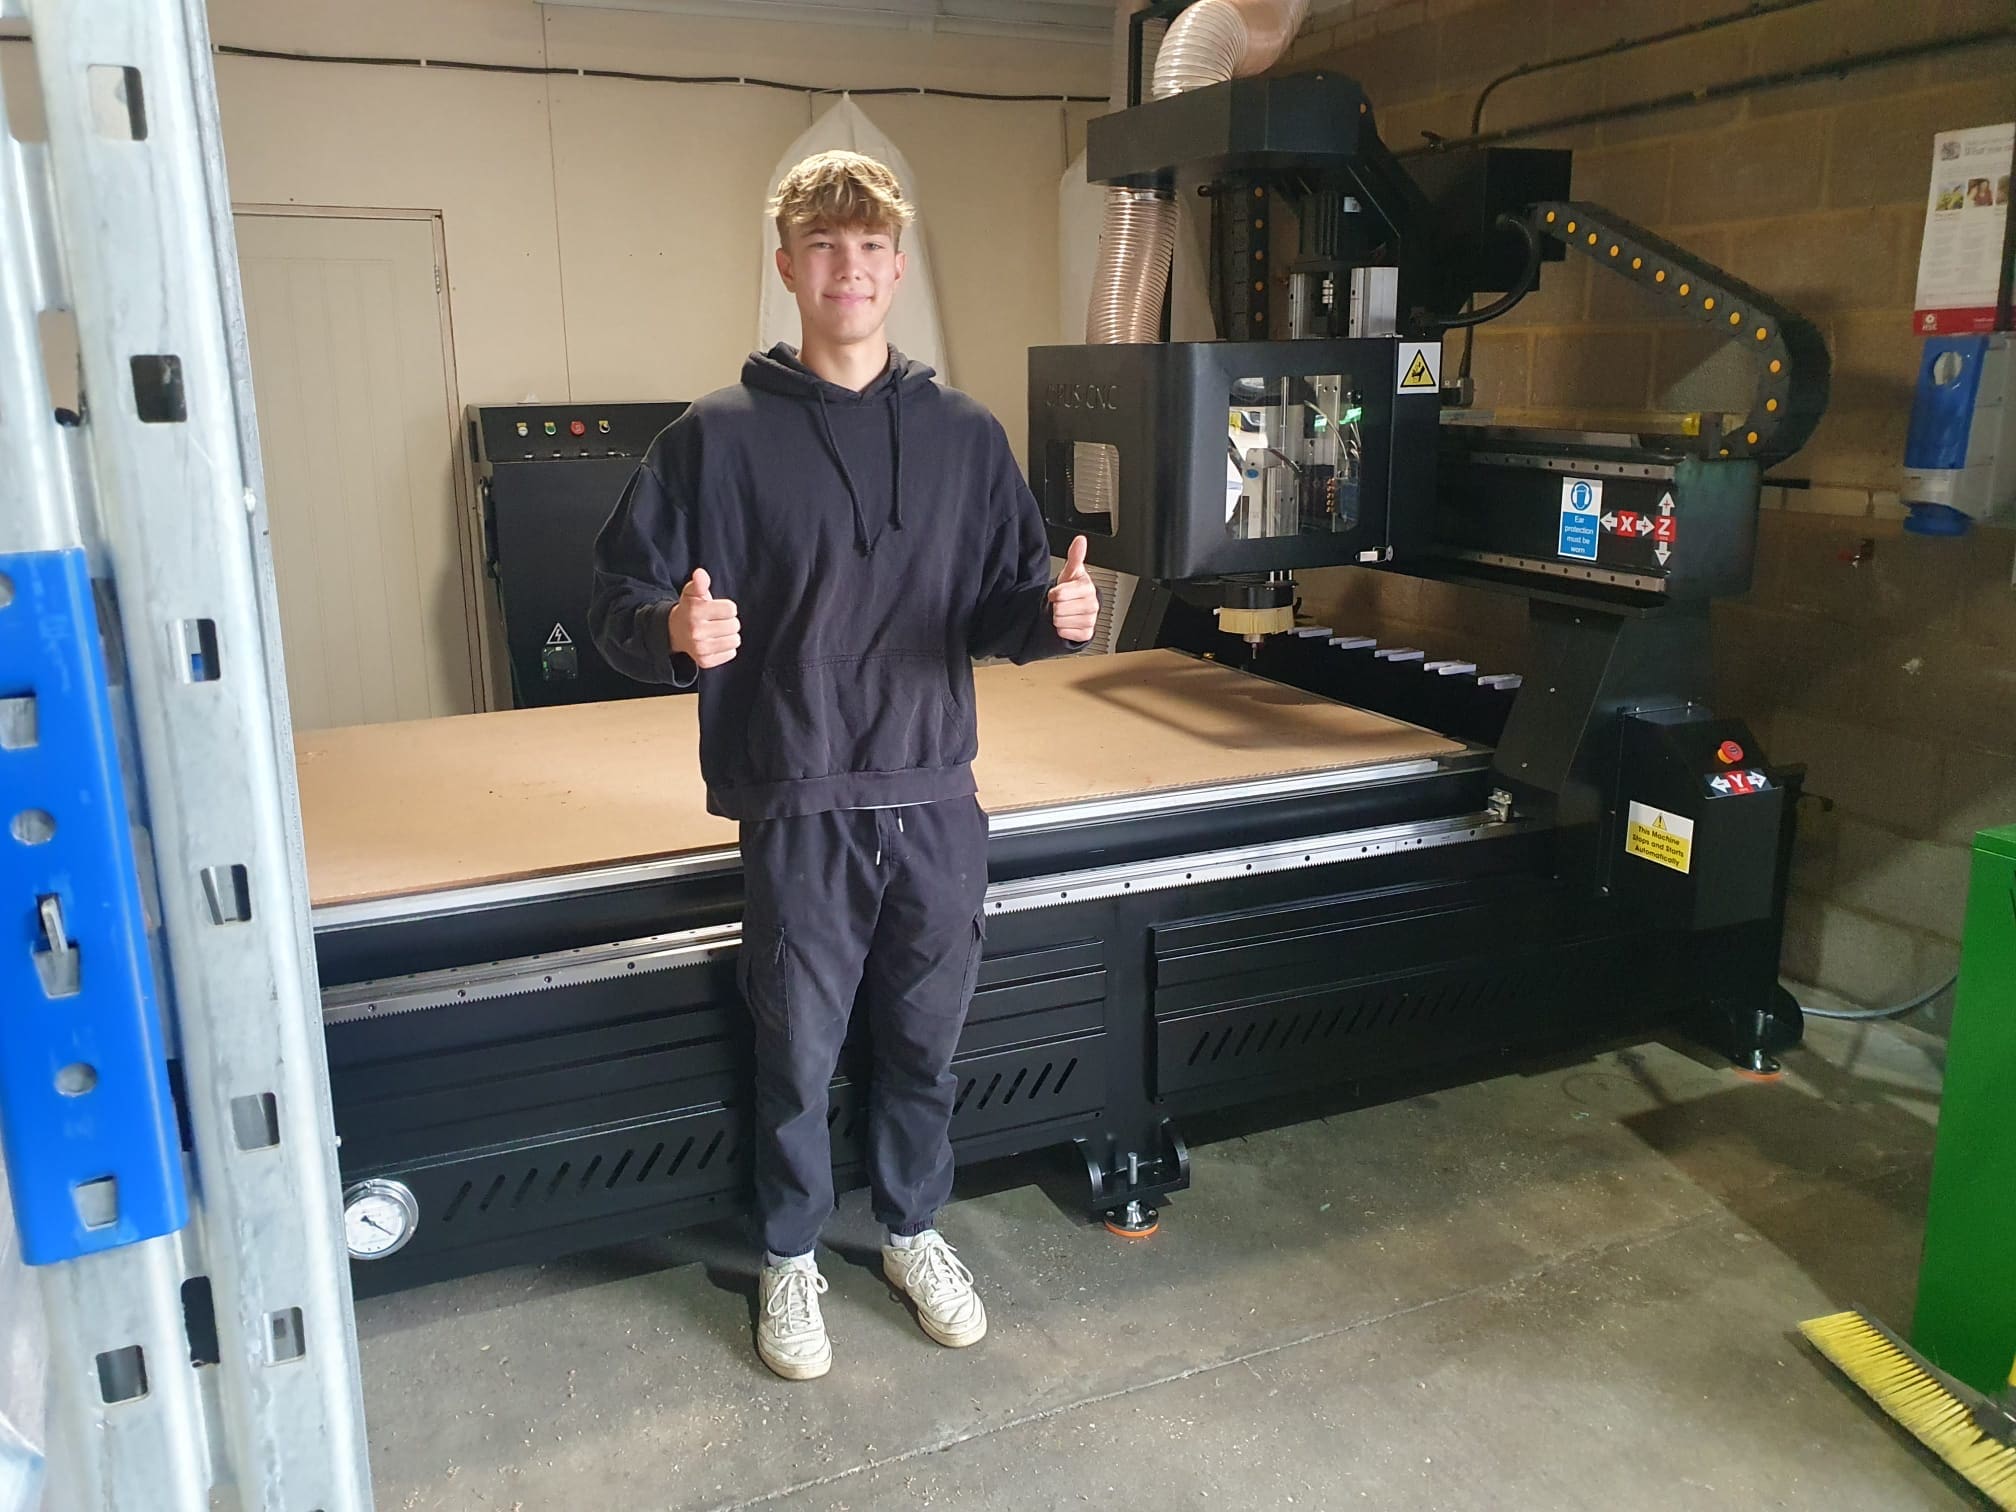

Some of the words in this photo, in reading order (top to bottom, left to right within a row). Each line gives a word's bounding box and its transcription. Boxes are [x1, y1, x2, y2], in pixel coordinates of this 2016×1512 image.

[1574, 516, 1585, 524] Ear
[1620, 516, 1634, 532] X
[1658, 518, 1671, 535] Z
[1565, 526, 1594, 535] protection
[1567, 536, 1581, 544] must
[1582, 537, 1590, 545] be
[1728, 774, 1743, 788] Y
[1638, 826, 1650, 836] This
[1651, 830, 1680, 846] Machine
[1632, 834, 1650, 846] Stops
[1651, 841, 1664, 851] and
[1666, 845, 1684, 858] Starts
[1635, 845, 1680, 866] Automatically
